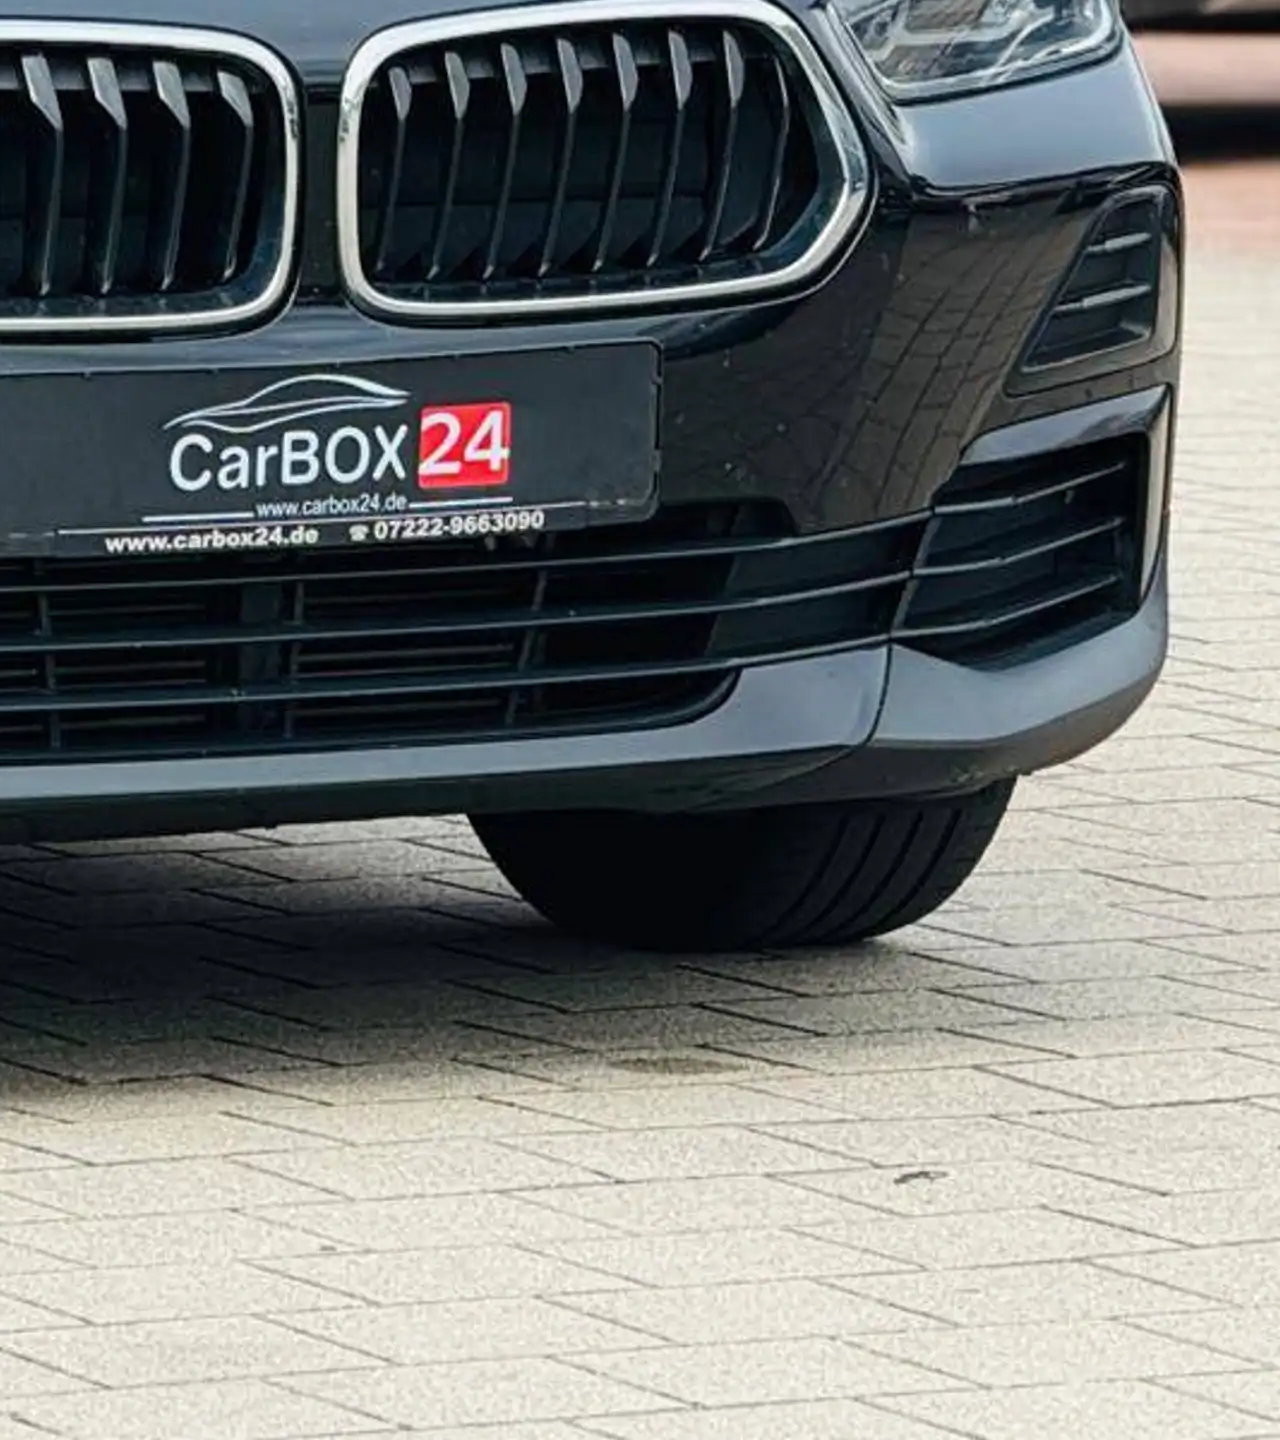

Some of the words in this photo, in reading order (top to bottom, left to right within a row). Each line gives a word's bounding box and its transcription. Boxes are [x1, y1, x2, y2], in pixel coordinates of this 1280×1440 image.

[256, 492, 407, 518] www.carbox24.de
[105, 526, 318, 554] www.carbox24.de
[374, 511, 544, 542] 07222-9663090
